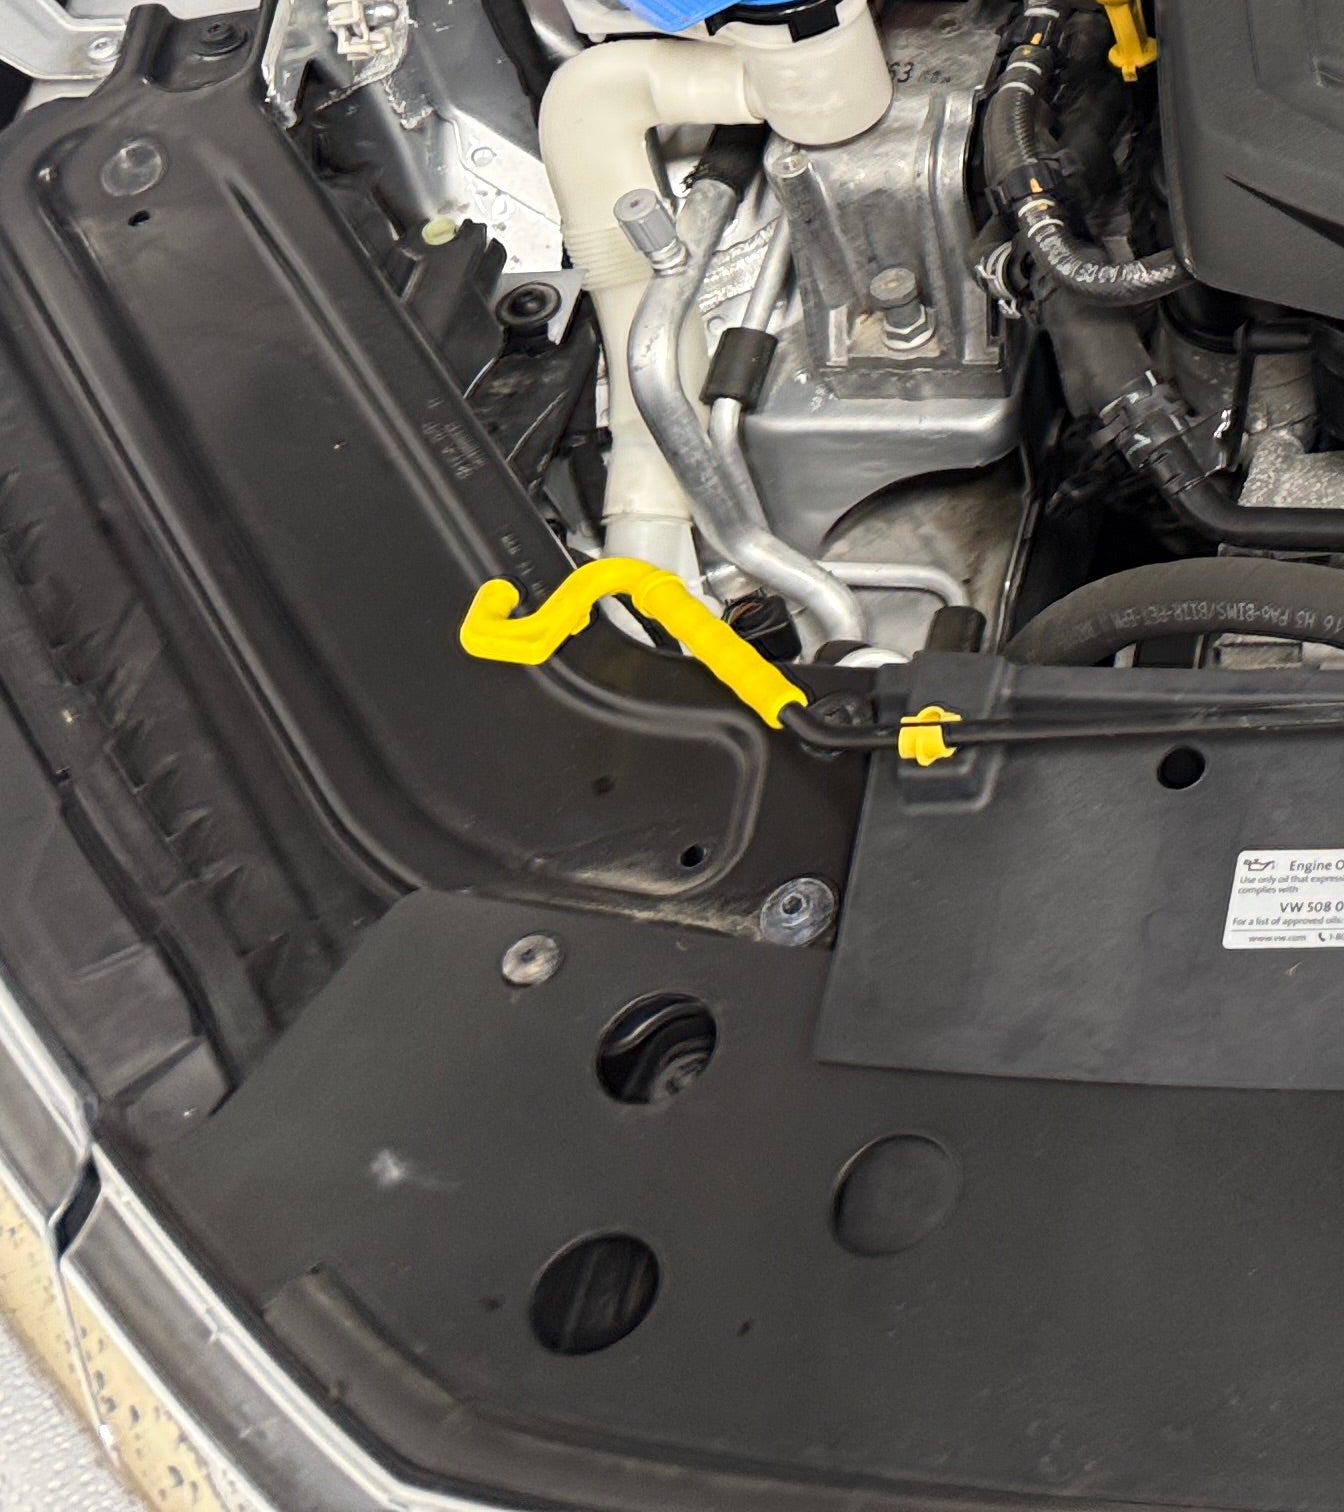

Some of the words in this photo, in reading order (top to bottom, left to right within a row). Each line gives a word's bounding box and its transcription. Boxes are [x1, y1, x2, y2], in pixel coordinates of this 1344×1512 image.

[1289, 860, 1332, 874] Engine
[1240, 875, 1257, 884] Use
[1258, 875, 1277, 885] only
[1290, 875, 1308, 883] that
[1238, 886, 1277, 896] complies
[1279, 885, 1299, 894] with
[1280, 901, 1304, 912] VW
[1306, 901, 1332, 912] 508
[1232, 917, 1248, 926] For
[1255, 917, 1269, 925] list
[1271, 916, 1281, 925] of
[1282, 916, 1325, 927] approved
